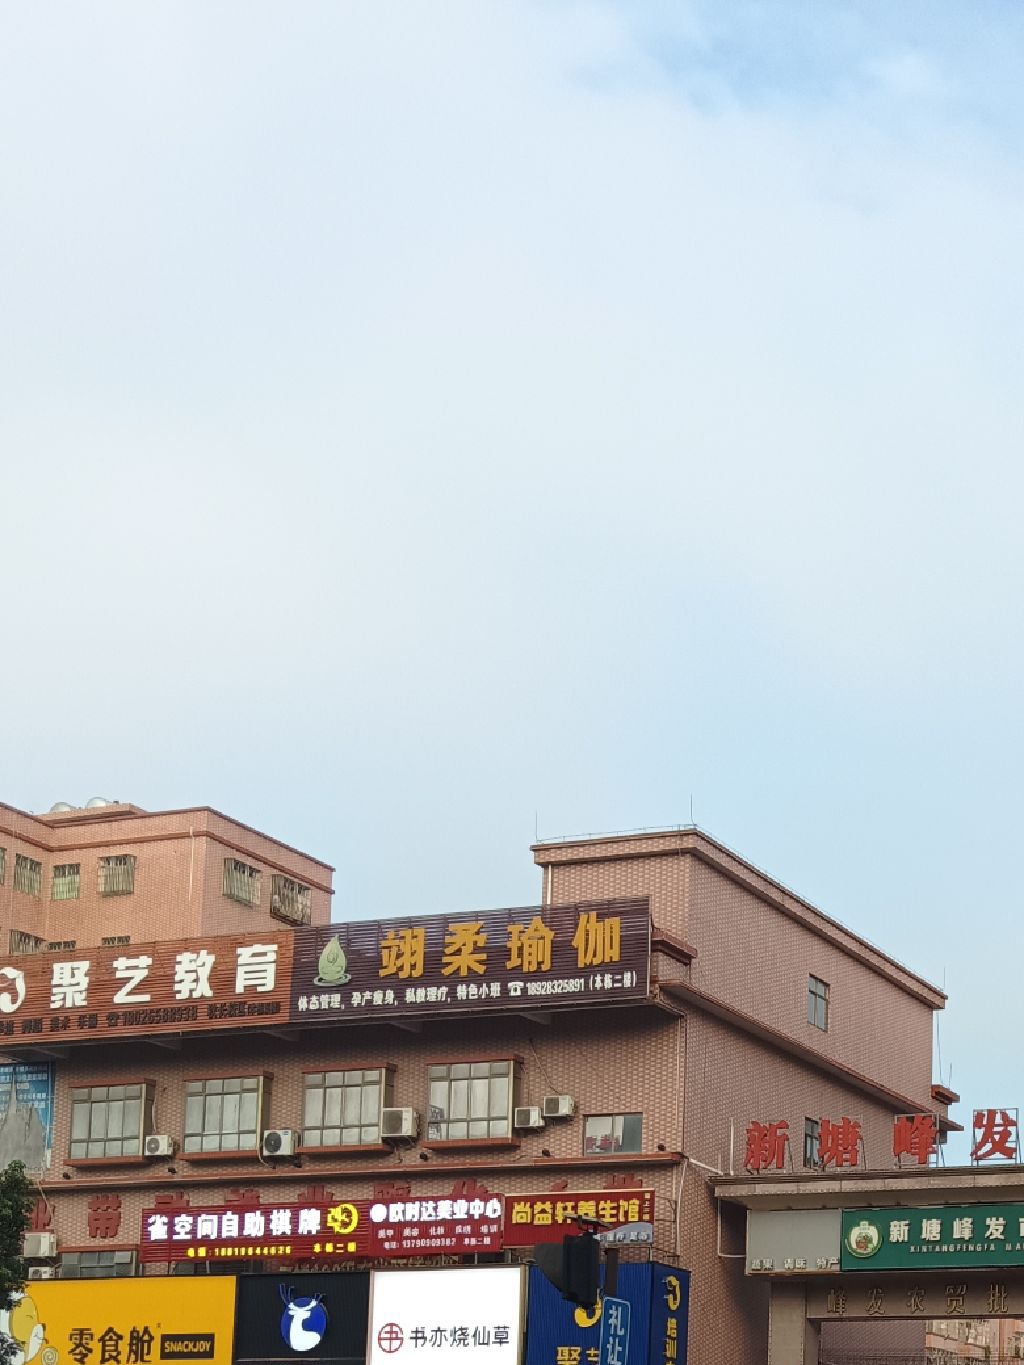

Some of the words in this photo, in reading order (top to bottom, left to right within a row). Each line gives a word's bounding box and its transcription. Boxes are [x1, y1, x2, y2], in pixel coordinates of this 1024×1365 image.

[379, 911, 621, 980] 翊柔瑜伽
[50, 944, 279, 1009] 聚艺教育
[68, 1326, 155, 1365] 零食舱
[164, 1340, 212, 1353] SNACKJOY
[410, 1325, 511, 1349] 书亦烧仙草
